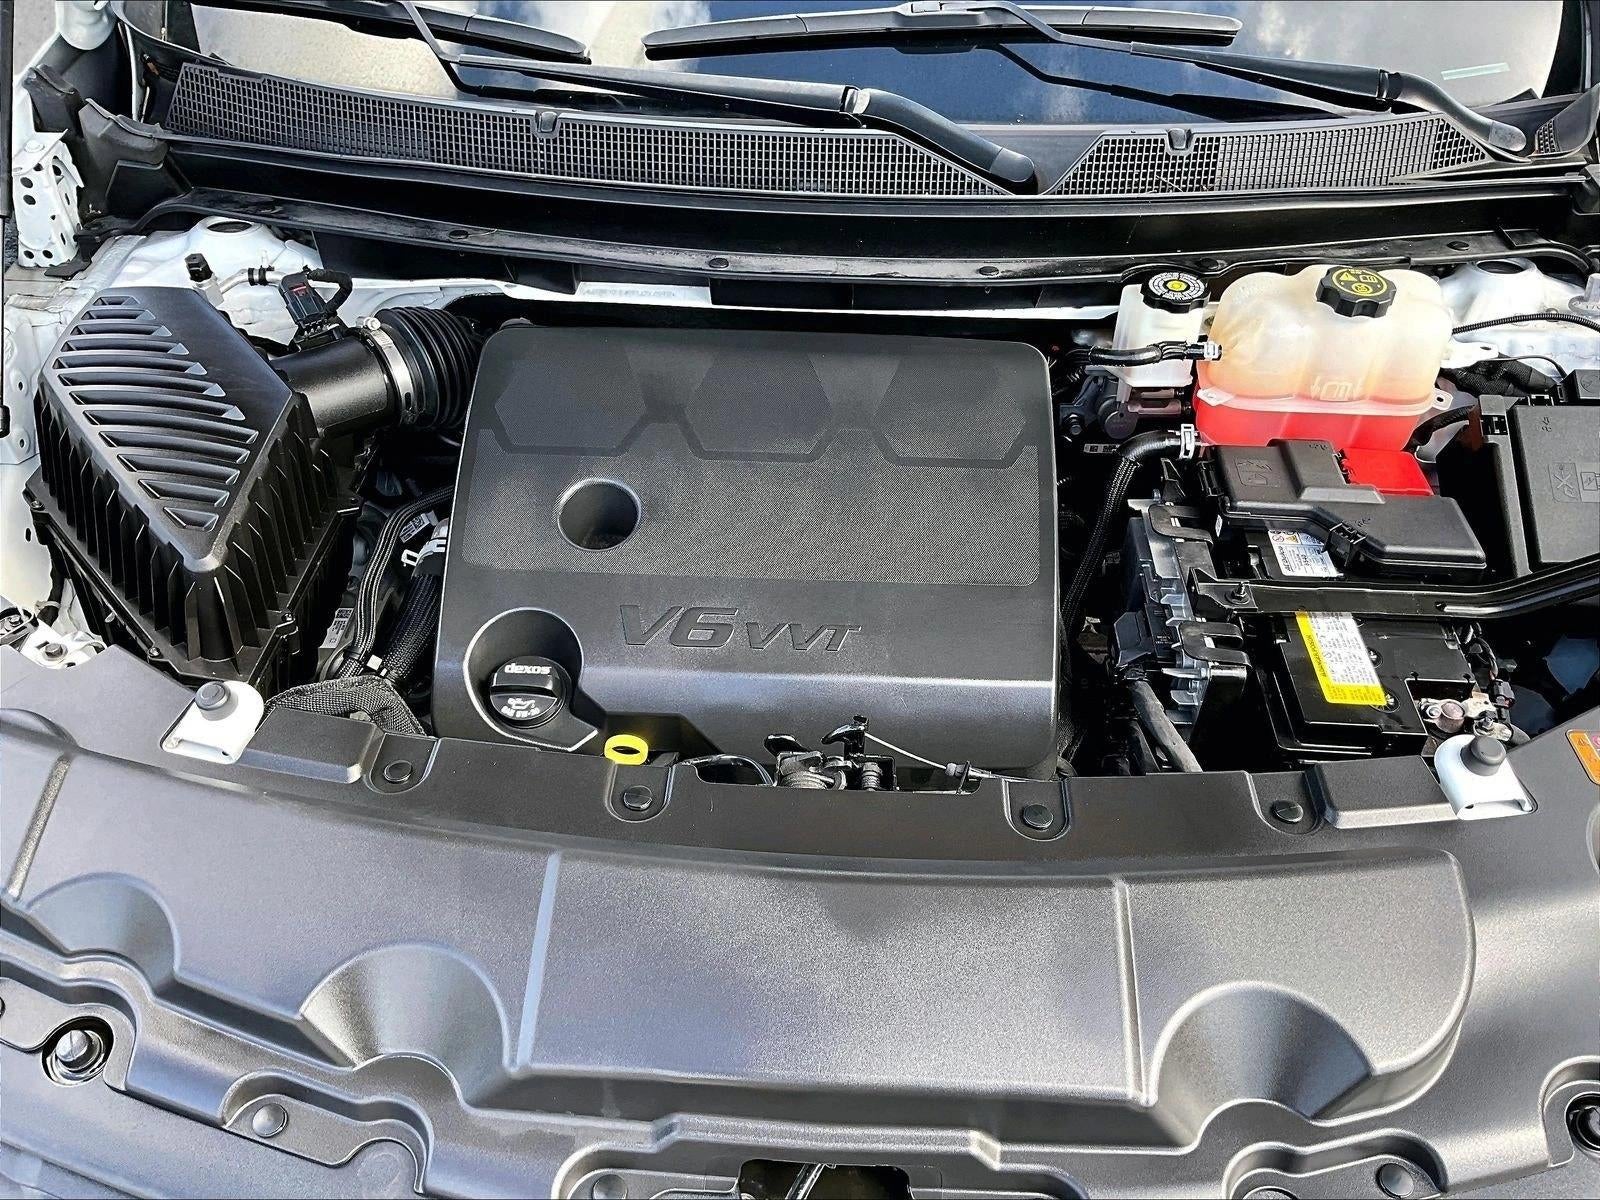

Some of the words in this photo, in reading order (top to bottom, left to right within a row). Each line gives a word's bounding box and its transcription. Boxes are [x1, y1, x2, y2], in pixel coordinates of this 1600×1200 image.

[620, 604, 739, 649] V6
[746, 621, 862, 652] VVT
[504, 662, 552, 675] dexos
